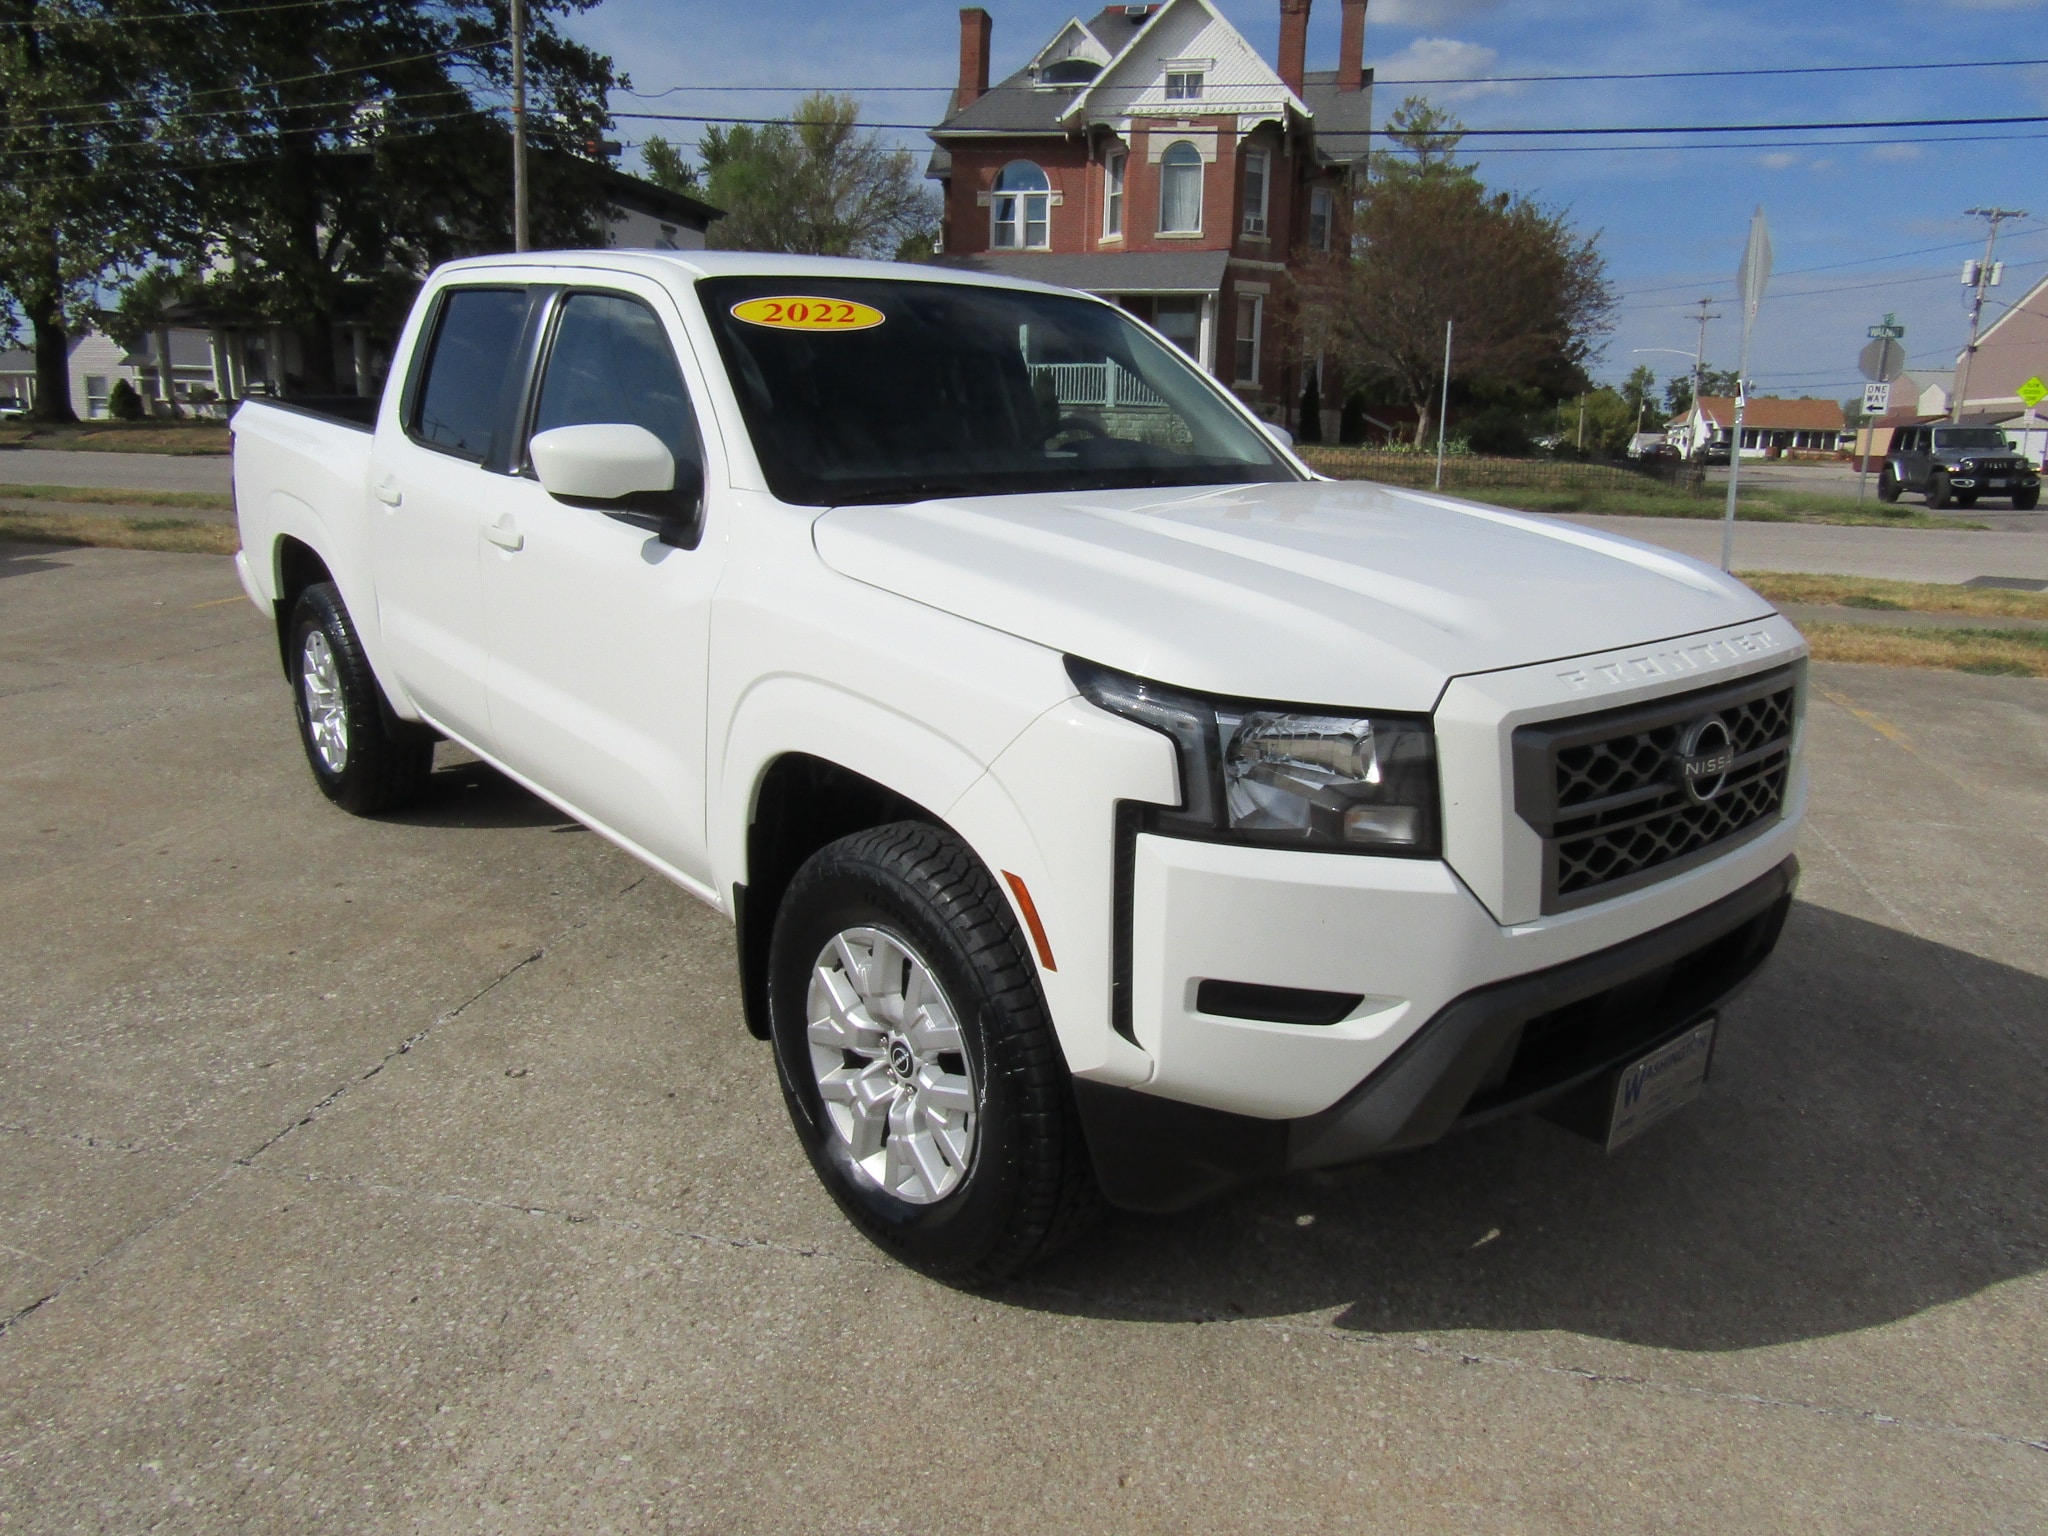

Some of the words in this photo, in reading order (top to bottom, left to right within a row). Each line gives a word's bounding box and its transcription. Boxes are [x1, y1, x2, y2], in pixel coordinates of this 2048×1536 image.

[762, 303, 856, 323] 2022
[1867, 385, 1887, 394] ONE
[1866, 395, 1887, 403] WAY
[1555, 629, 1781, 691] FRONTIER
